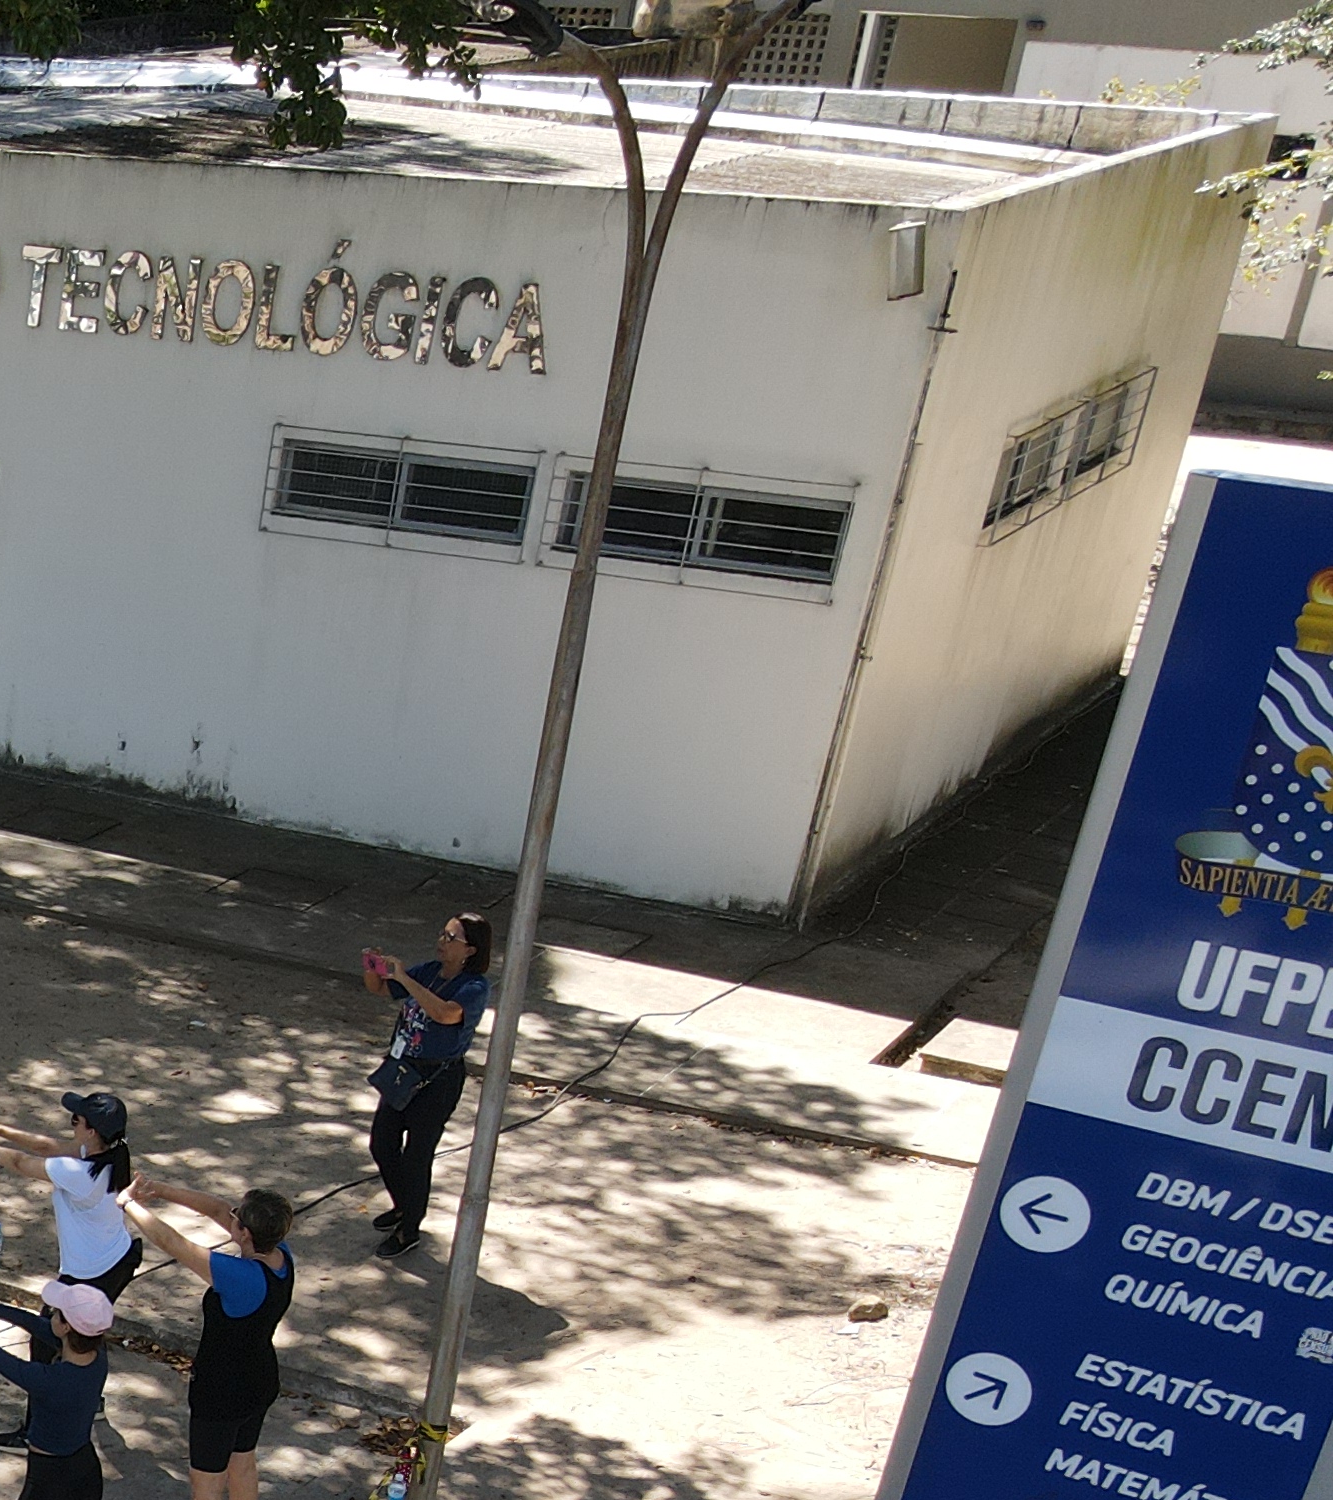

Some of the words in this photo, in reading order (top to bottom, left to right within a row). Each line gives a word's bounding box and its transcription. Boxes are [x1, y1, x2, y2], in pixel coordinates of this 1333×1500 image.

[21, 237, 548, 376] TECNOLÓGICA
[1179, 857, 1299, 905] SAPIENTIA
[1136, 1171, 1232, 1217] DBM
[1104, 1274, 1264, 1339] QUÍMICA
[1075, 1353, 1306, 1441] ESTATÍSTICA
[1058, 1401, 1175, 1457] FÍSICA
